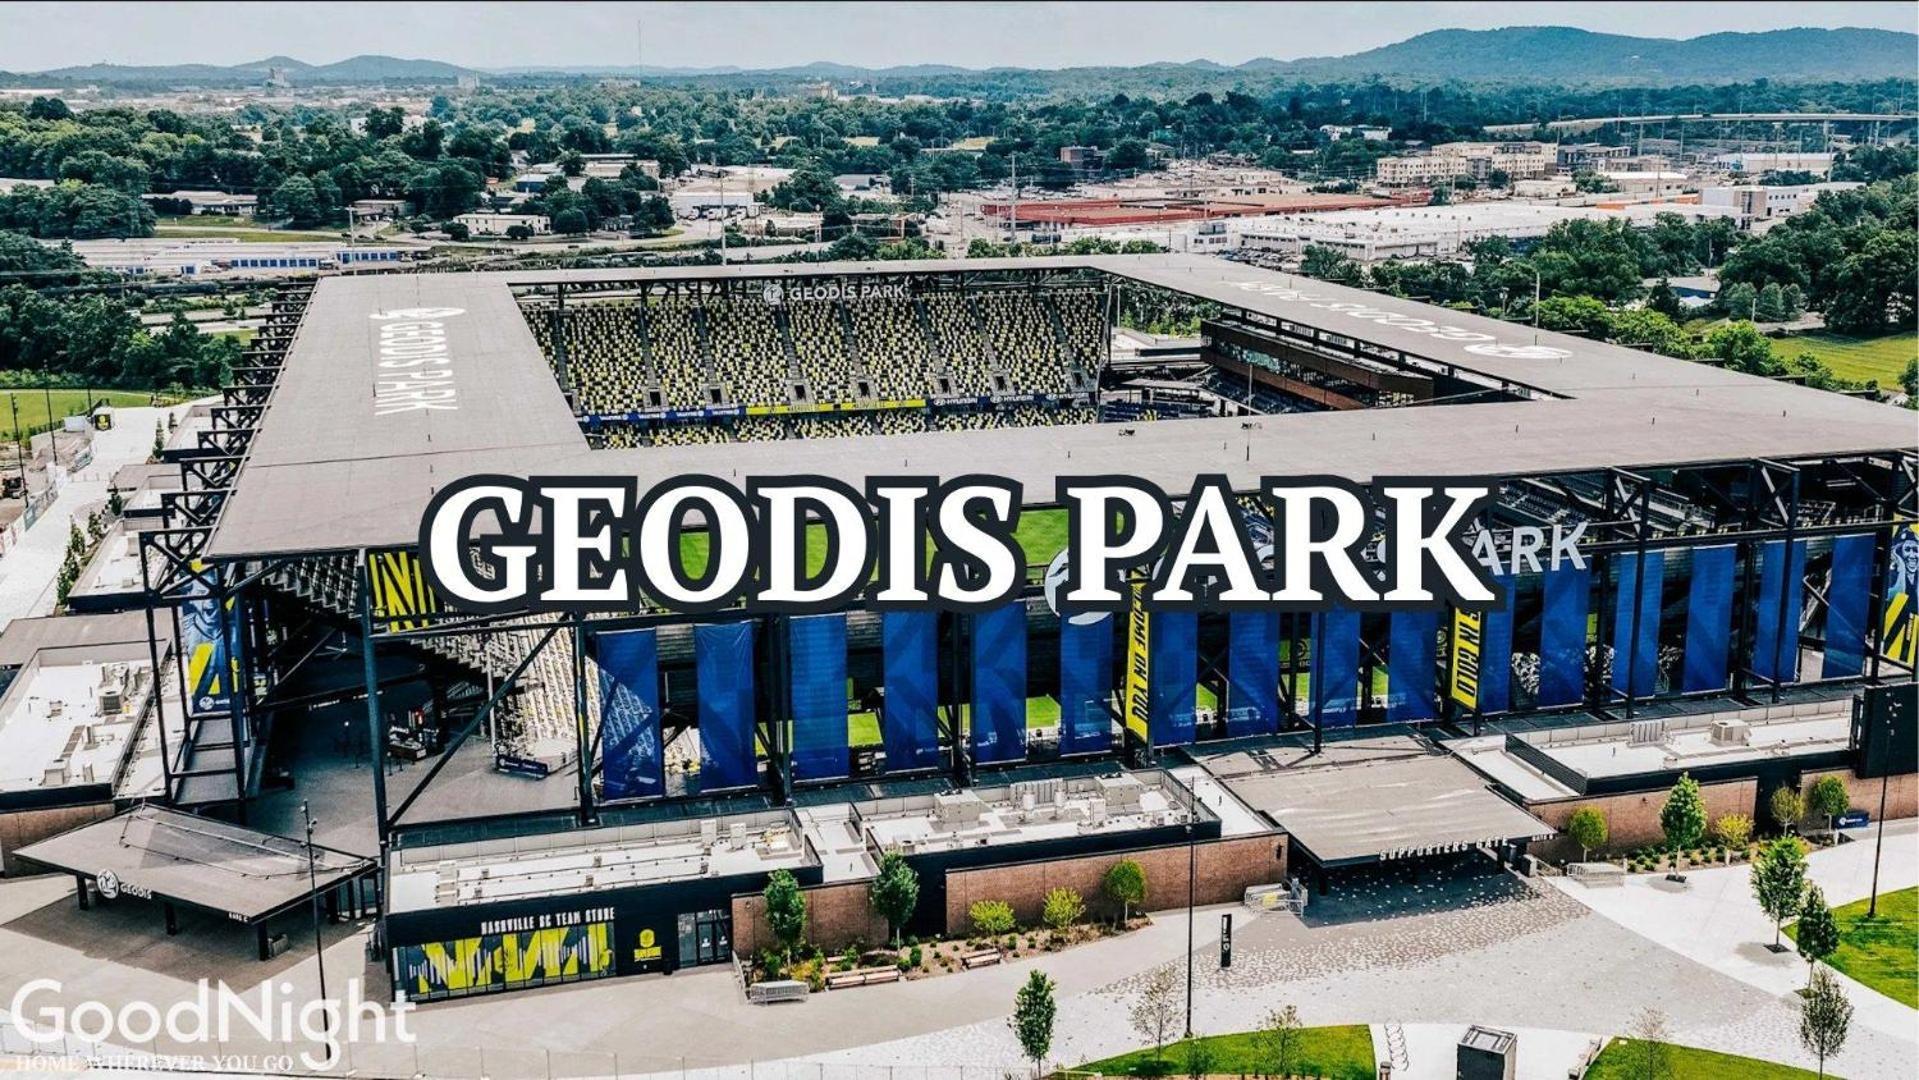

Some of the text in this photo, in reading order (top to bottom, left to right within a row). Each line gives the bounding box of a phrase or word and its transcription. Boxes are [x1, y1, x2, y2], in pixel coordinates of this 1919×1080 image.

[789, 284, 905, 301] GEODIS PARK
[375, 321, 459, 416] GEODIS PARK
[1471, 519, 1589, 576] ARK
[1379, 835, 1509, 861] SUPPORTERS GATE
[120, 882, 152, 900] GEODIS
[481, 916, 535, 936] NASHVILLE
[555, 911, 581, 926] TEAM
[585, 907, 615, 923] STORE
